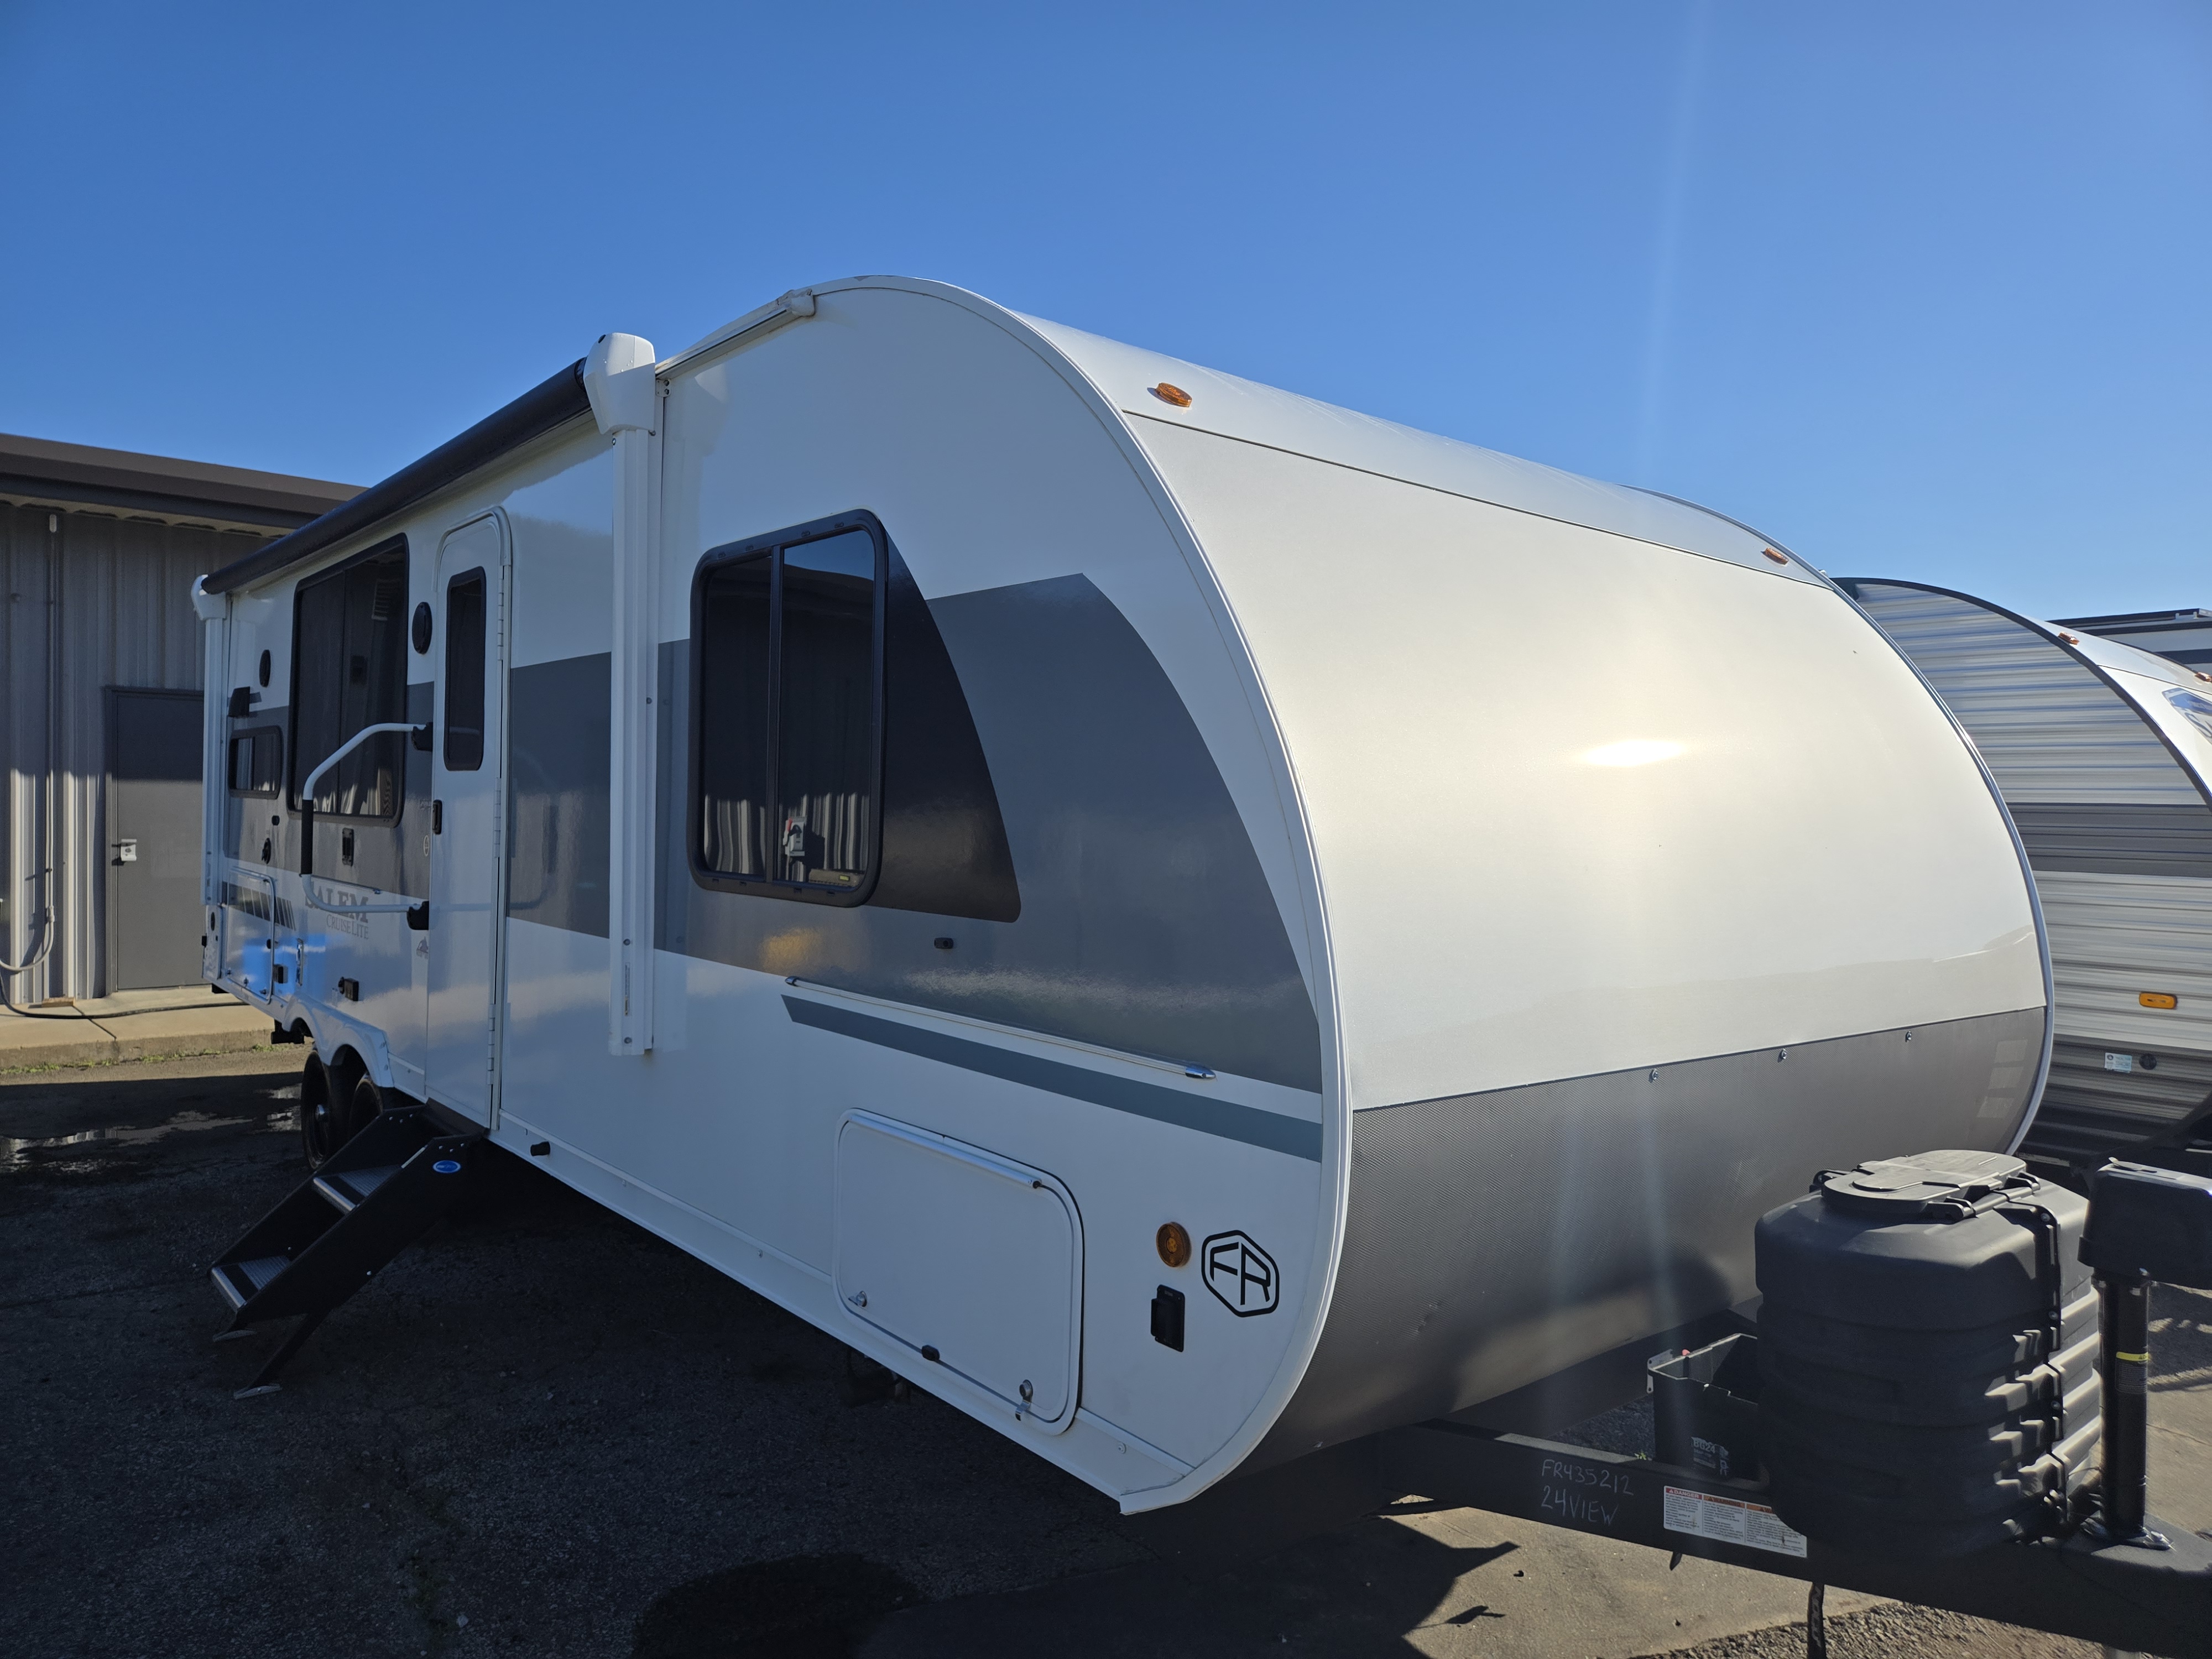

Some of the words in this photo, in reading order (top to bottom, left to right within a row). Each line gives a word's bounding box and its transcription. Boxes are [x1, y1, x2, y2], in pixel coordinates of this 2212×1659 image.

[1210, 1241, 1271, 1306] FR
[1542, 1459, 1634, 1495] FR435212
[1674, 1490, 1699, 1499] DANGER
[1541, 1485, 1618, 1526] 24VIEW
